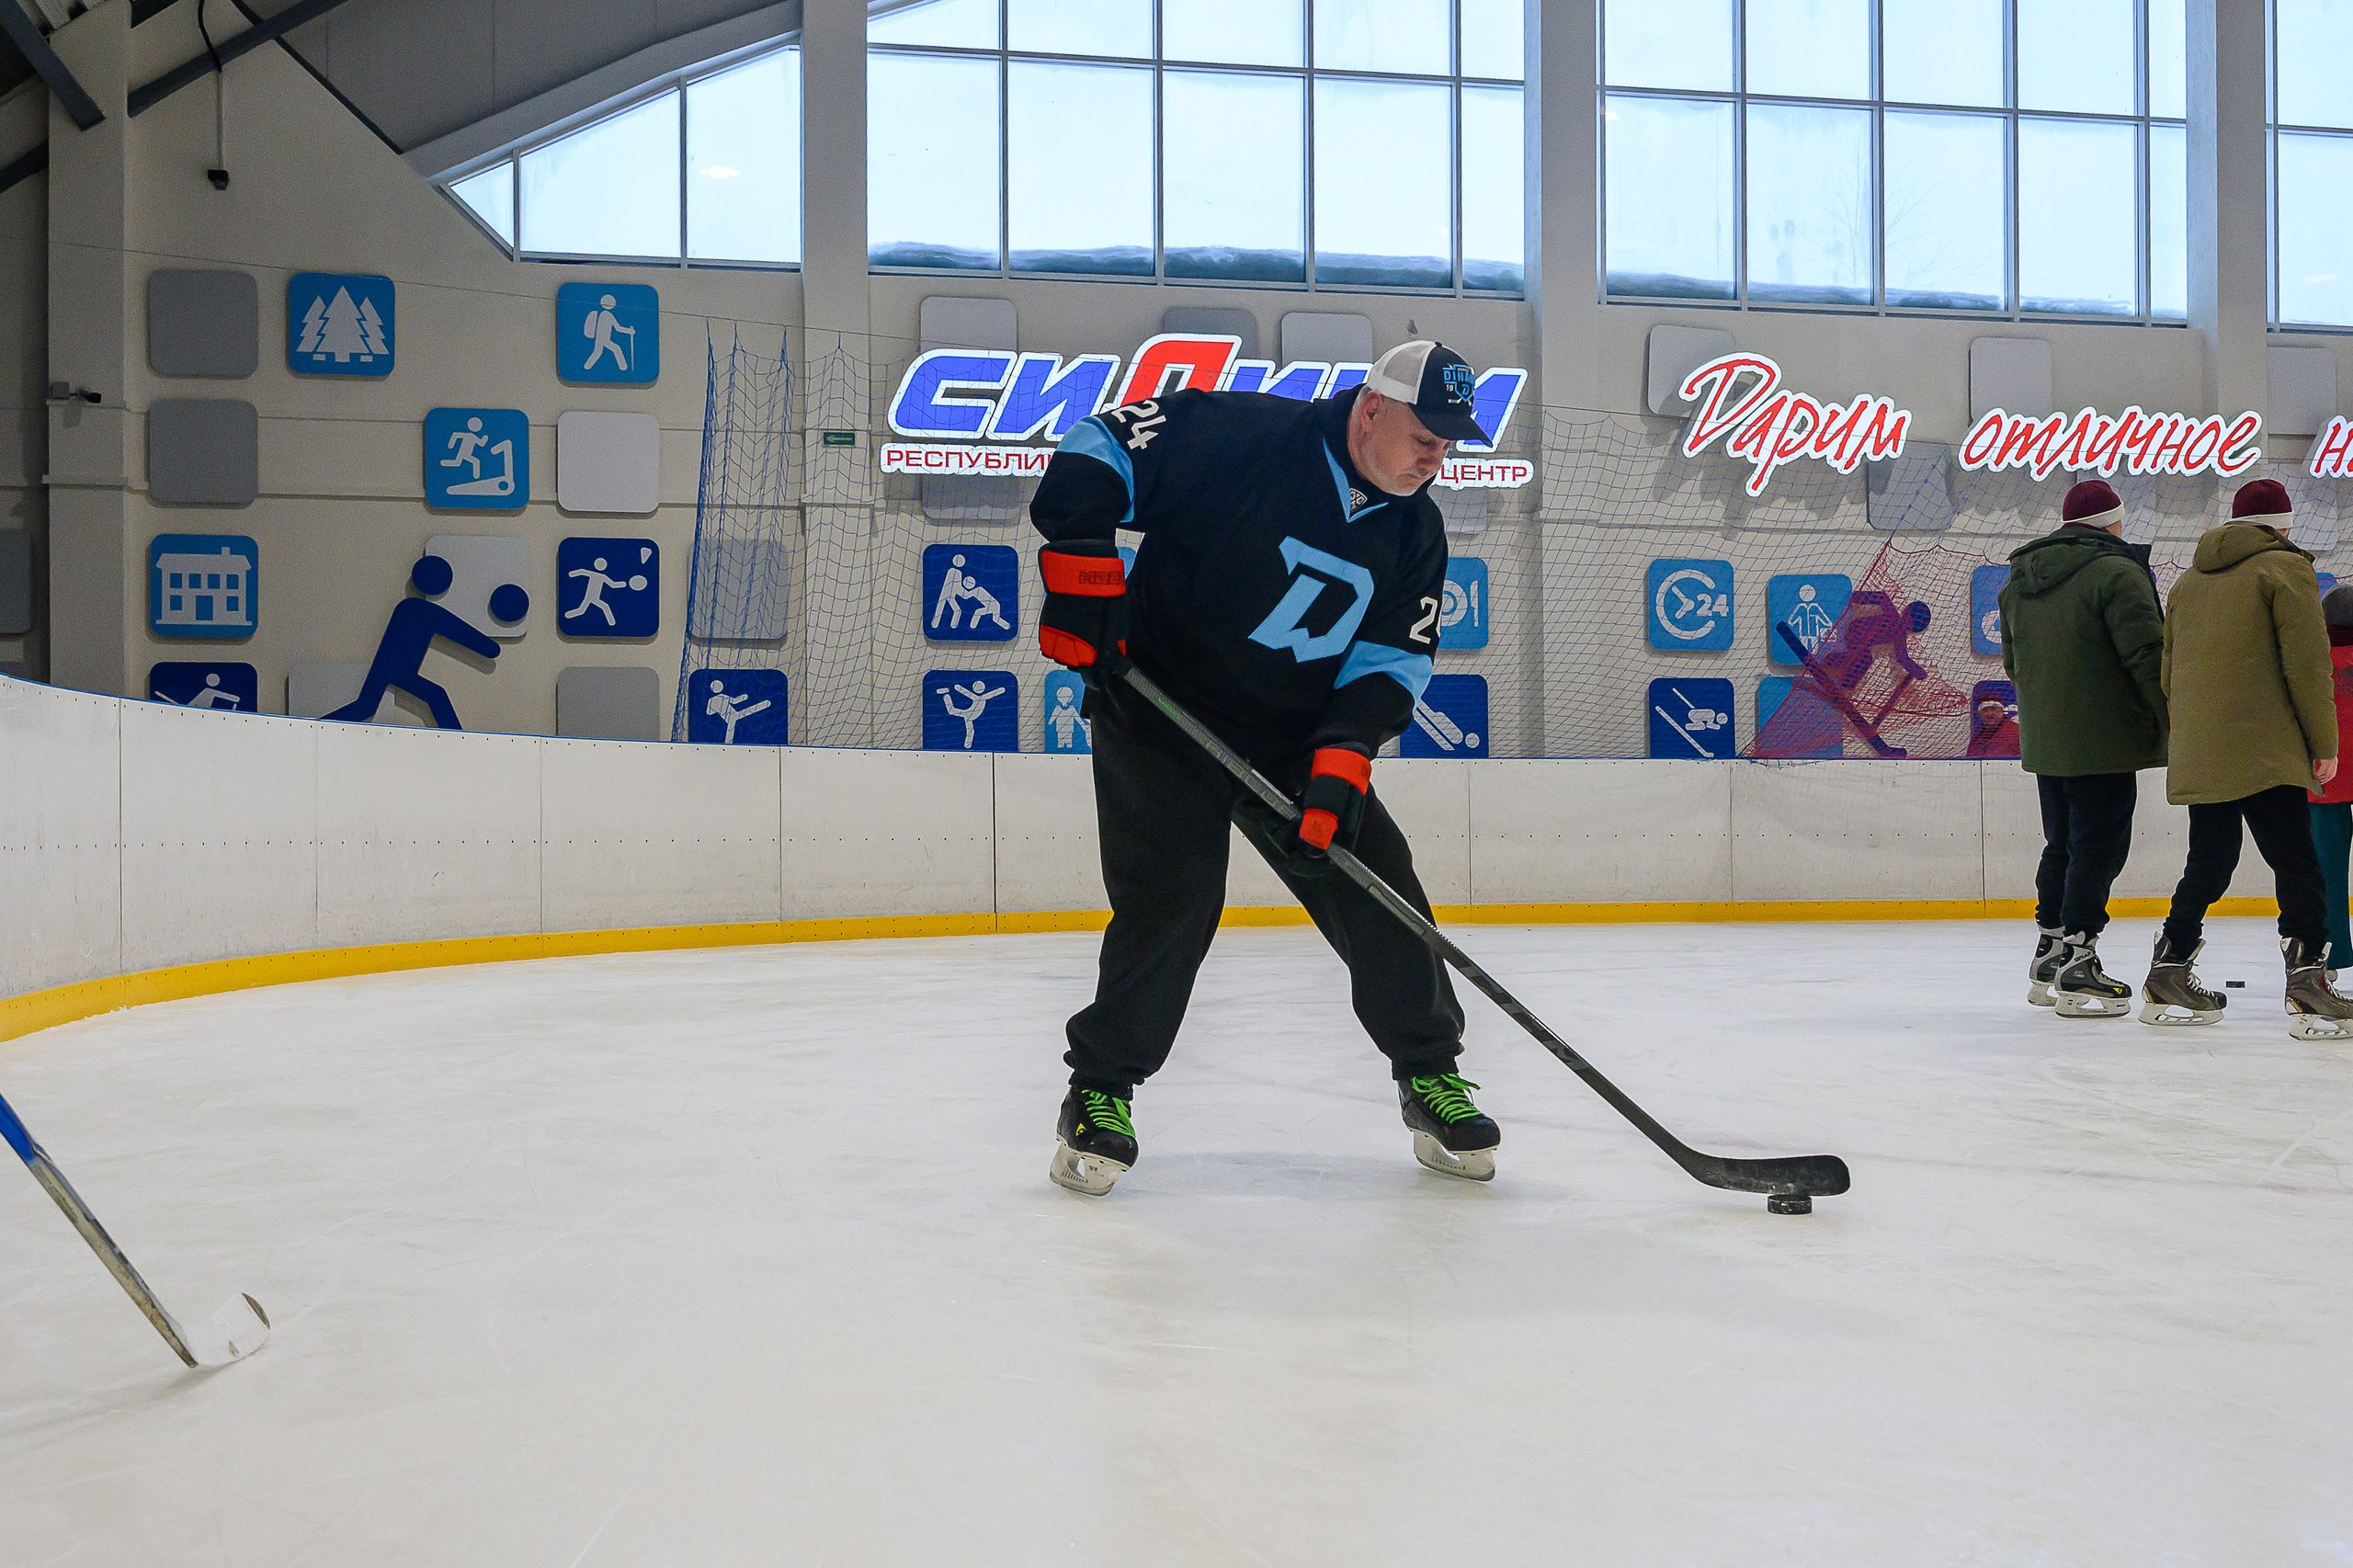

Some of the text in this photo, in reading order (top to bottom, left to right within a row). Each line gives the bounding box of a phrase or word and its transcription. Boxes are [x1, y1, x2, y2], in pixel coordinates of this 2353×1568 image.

[1443, 370, 1475, 384] DINA
[1110, 399, 1167, 450] 24
[1681, 356, 2353, 494] Дарим отличное н
[887, 449, 1528, 484] РЕСПУБЛИ ЦЕНТР
[1409, 596, 1441, 644] 2
[1696, 593, 1730, 618] 24
